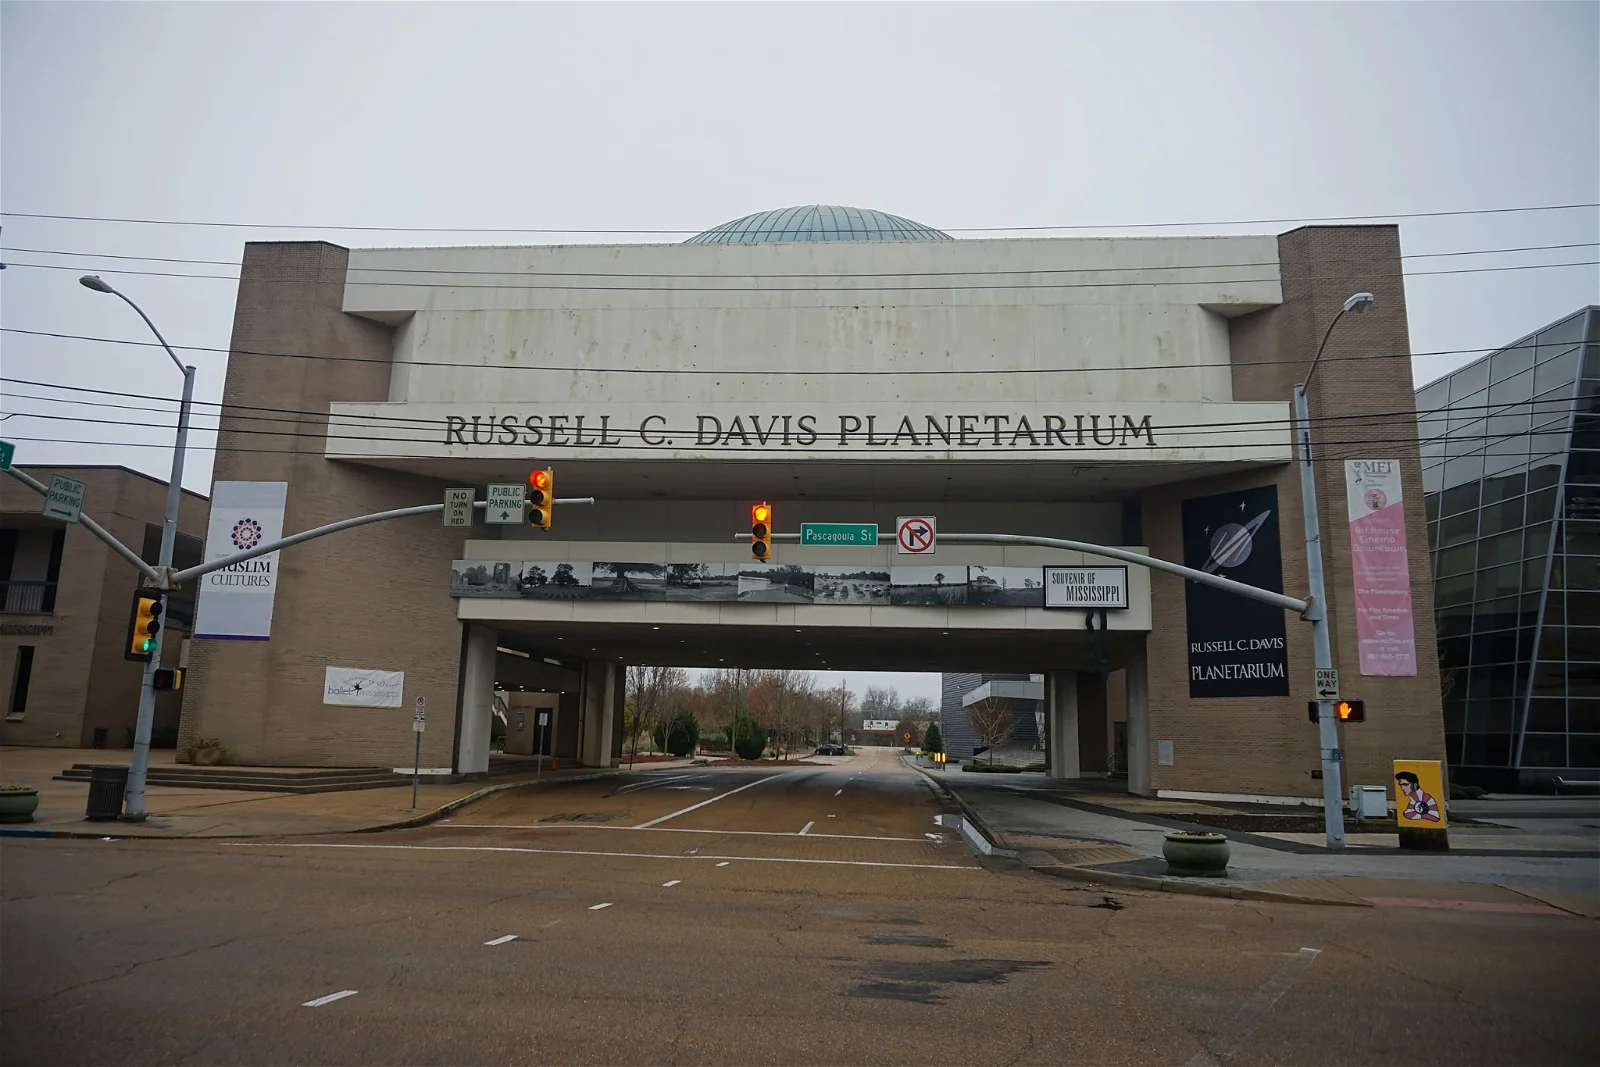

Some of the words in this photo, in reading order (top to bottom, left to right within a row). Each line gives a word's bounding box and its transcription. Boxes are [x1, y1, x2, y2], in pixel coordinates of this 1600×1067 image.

[444, 415, 621, 446] RUSSELL
[640, 415, 673, 446] C.
[695, 415, 817, 446] DAVIS
[838, 414, 1157, 446] PLANETARIUM
[1363, 461, 1392, 473] MFI
[54, 478, 82, 494] PUBLIC
[492, 487, 520, 497] PUBLIC
[48, 490, 80, 508] PARKING
[452, 492, 467, 500] NO
[489, 499, 522, 509] PARKING
[806, 528, 855, 543] Pascagoula
[861, 529, 872, 541] St
[1353, 543, 1406, 552] Downtown
[215, 560, 271, 573] USLIM
[211, 574, 271, 587] CULTURES
[1051, 572, 1085, 585] SOUVENIR
[1087, 572, 1096, 585] OF
[1066, 585, 1120, 602] MISSISSIPPI
[1191, 640, 1235, 653] RUSSELL
[1236, 639, 1249, 651] C.
[1250, 637, 1284, 650] DAVIS
[1191, 662, 1285, 681] PLANETARIUM
[1316, 670, 1336, 679] ONE
[1316, 679, 1337, 688] WAY
[327, 685, 352, 696] ballet
